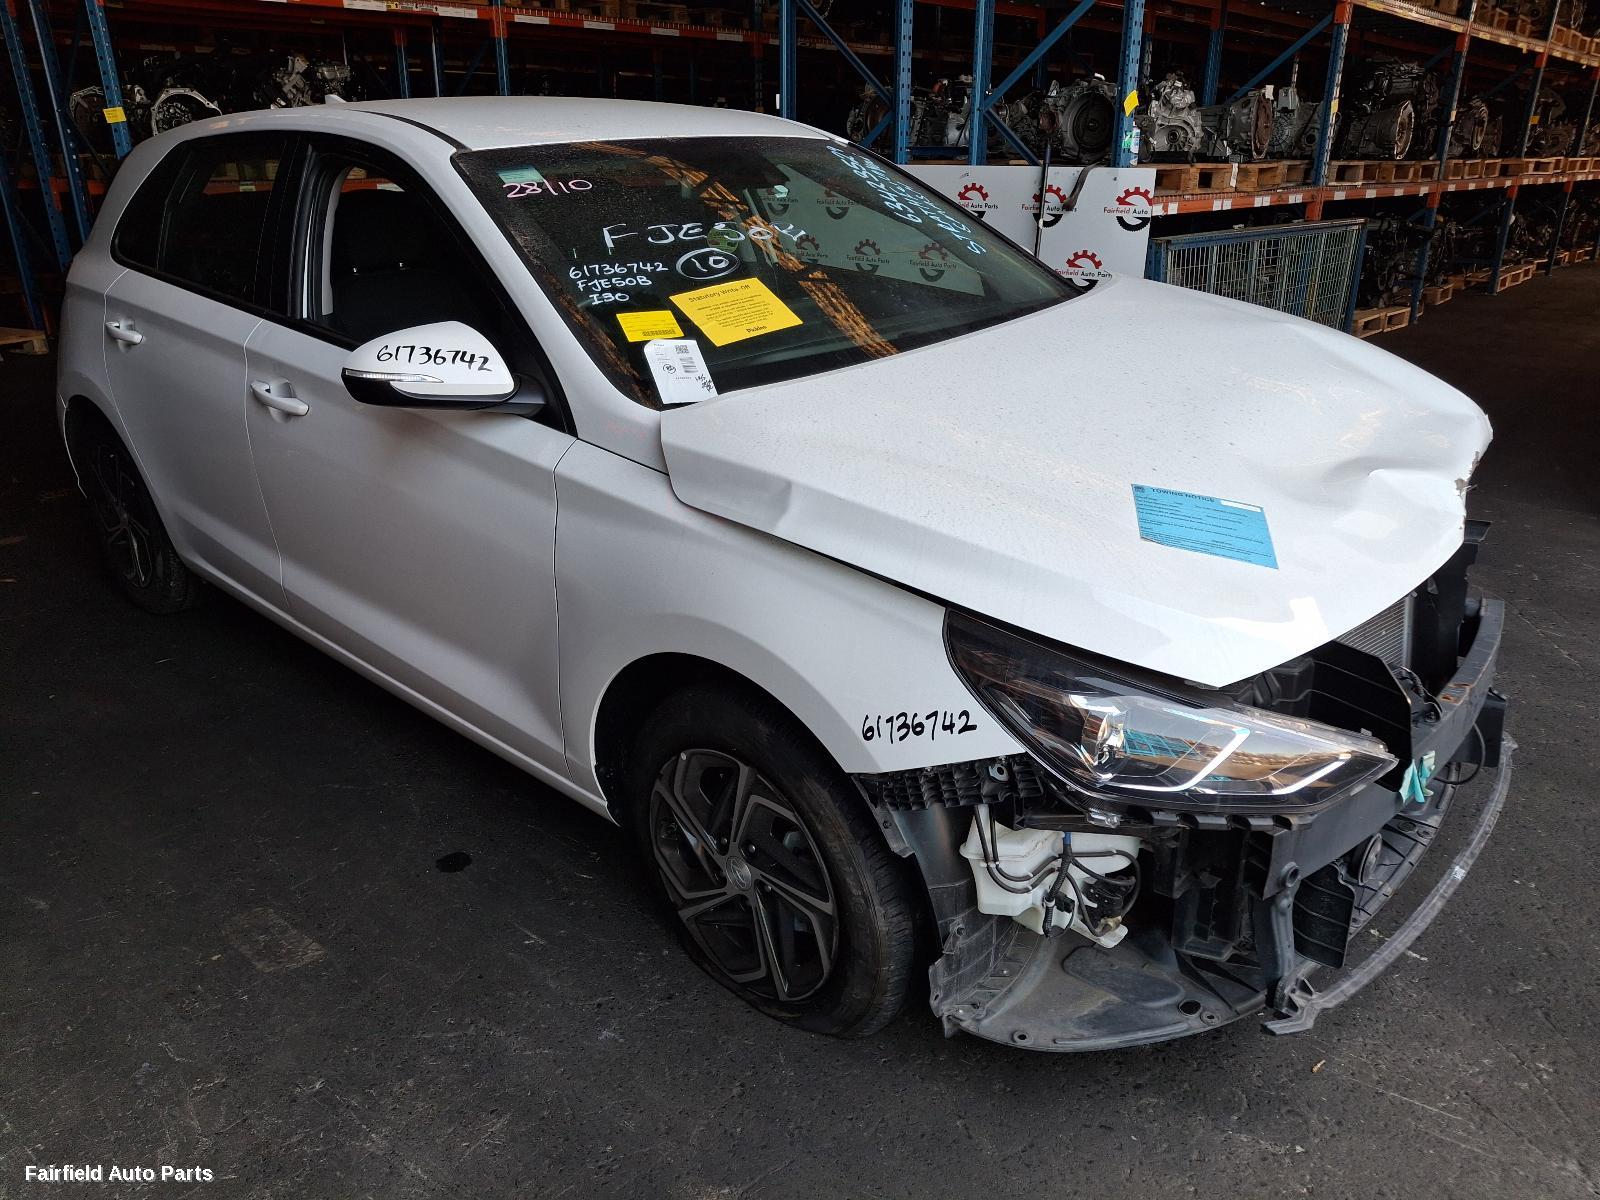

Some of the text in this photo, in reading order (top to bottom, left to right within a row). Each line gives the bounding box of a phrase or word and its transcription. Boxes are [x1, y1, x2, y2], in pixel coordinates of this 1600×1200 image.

[502, 178, 592, 198] 28/10
[984, 202, 999, 210] Parts
[1103, 206, 1131, 214] Fairfield
[568, 261, 669, 279] 61736742
[576, 275, 653, 292] FJE50B
[376, 345, 493, 372] 61736742
[862, 709, 978, 745] 61736742
